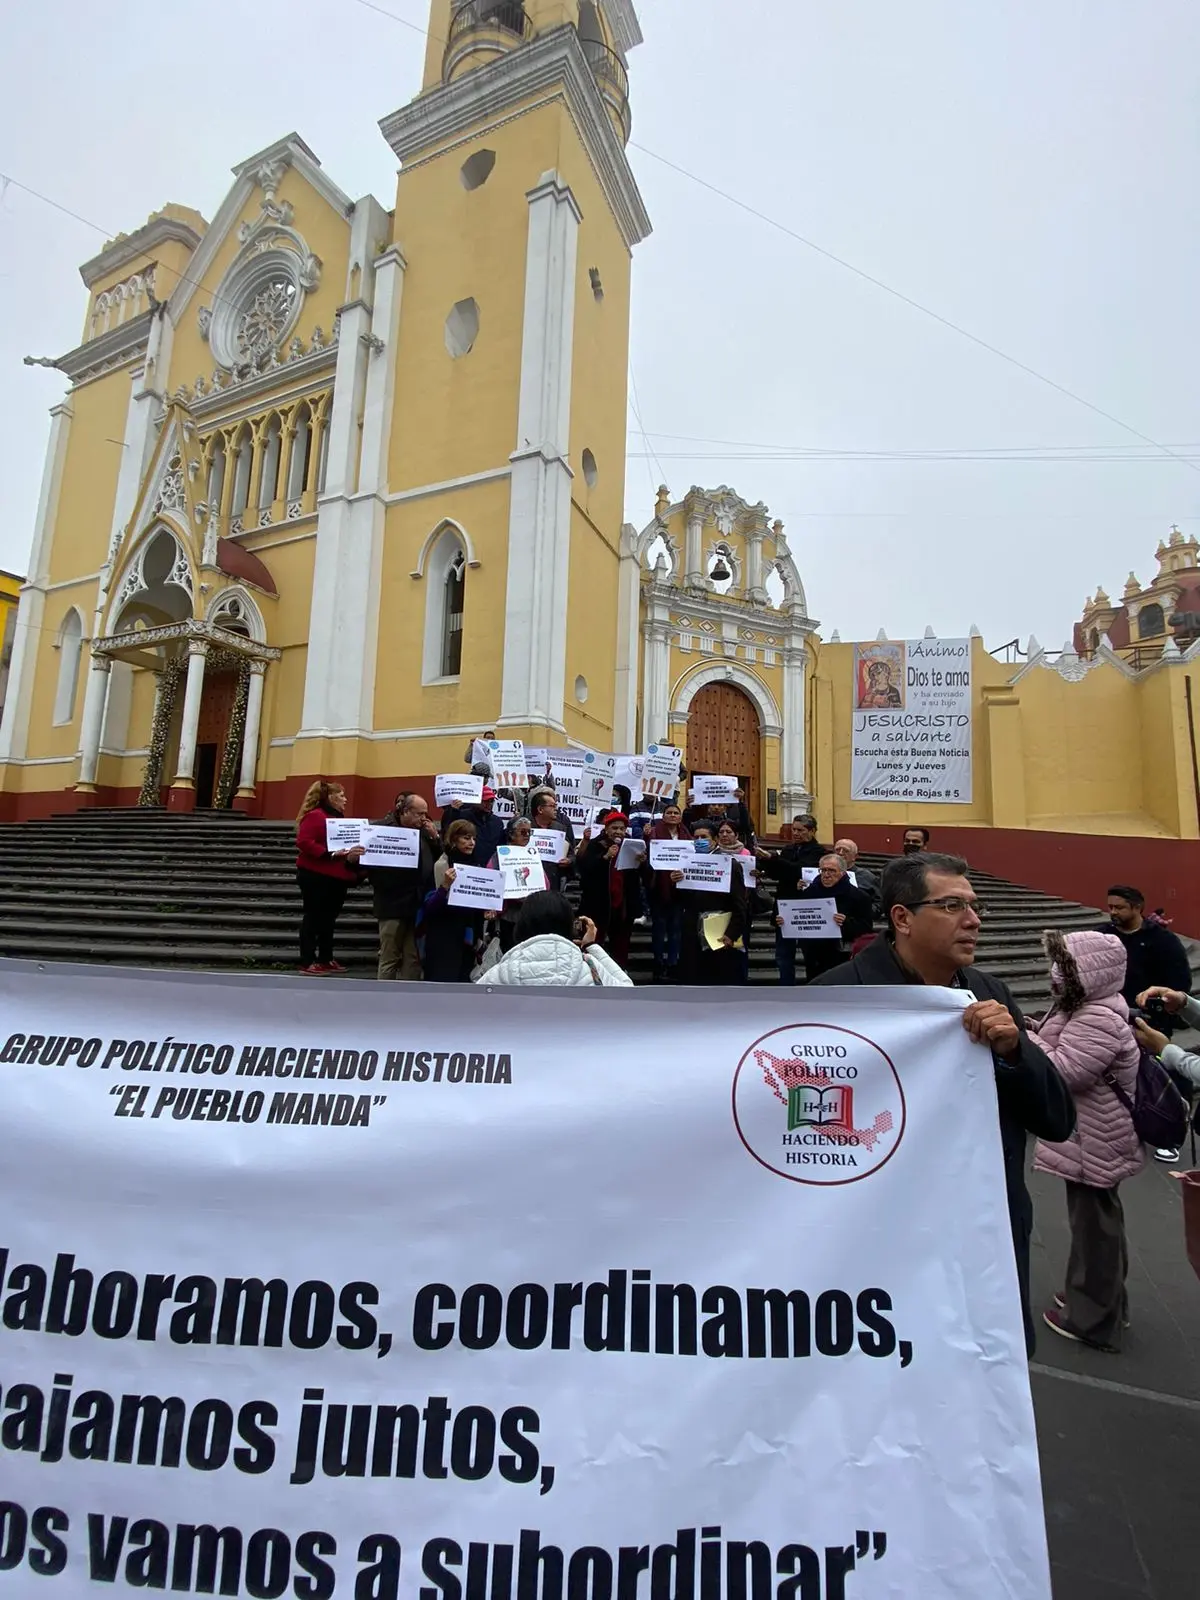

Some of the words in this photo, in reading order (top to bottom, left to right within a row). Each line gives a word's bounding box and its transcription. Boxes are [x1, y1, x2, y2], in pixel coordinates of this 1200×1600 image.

[908, 666, 928, 687] Dios
[932, 668, 942, 686] te
[945, 671, 970, 686] ama
[855, 714, 970, 732] JESUCRISTO
[872, 732, 880, 742] a
[886, 730, 952, 742] salvarte
[854, 748, 888, 756] Escucha
[890, 748, 908, 756] ésta
[910, 748, 937, 757] Buena
[939, 748, 970, 757] Noticia
[876, 762, 904, 770] Lunes
[914, 762, 946, 770] Jueves
[890, 775, 910, 783] 8:30
[912, 776, 932, 784] p.m.
[863, 788, 900, 798] Callejón
[902, 788, 914, 796] de
[916, 789, 940, 798] Rojas
[954, 790, 960, 798] 5
[791, 1044, 847, 1058] GRUPO
[0, 1034, 103, 1068] GRUPO
[101, 1037, 235, 1076] POLÍTICO
[236, 1046, 379, 1081] HACIENDO
[383, 1052, 512, 1084] HISTORIA
[784, 1062, 858, 1079] POLÍTICO
[110, 1085, 150, 1118] “EL
[151, 1087, 264, 1124] PUEBLO
[267, 1092, 387, 1127] MANDA”
[782, 1134, 860, 1146] HACIENDO
[786, 1152, 858, 1166] HISTORIA
[0, 1248, 393, 1358] aboramos,
[413, 1269, 913, 1369] coordinamos,
[0, 1374, 278, 1475] ajamos
[290, 1387, 555, 1496] juntos,
[88, 1513, 336, 1600] vamos
[355, 1533, 401, 1600] a
